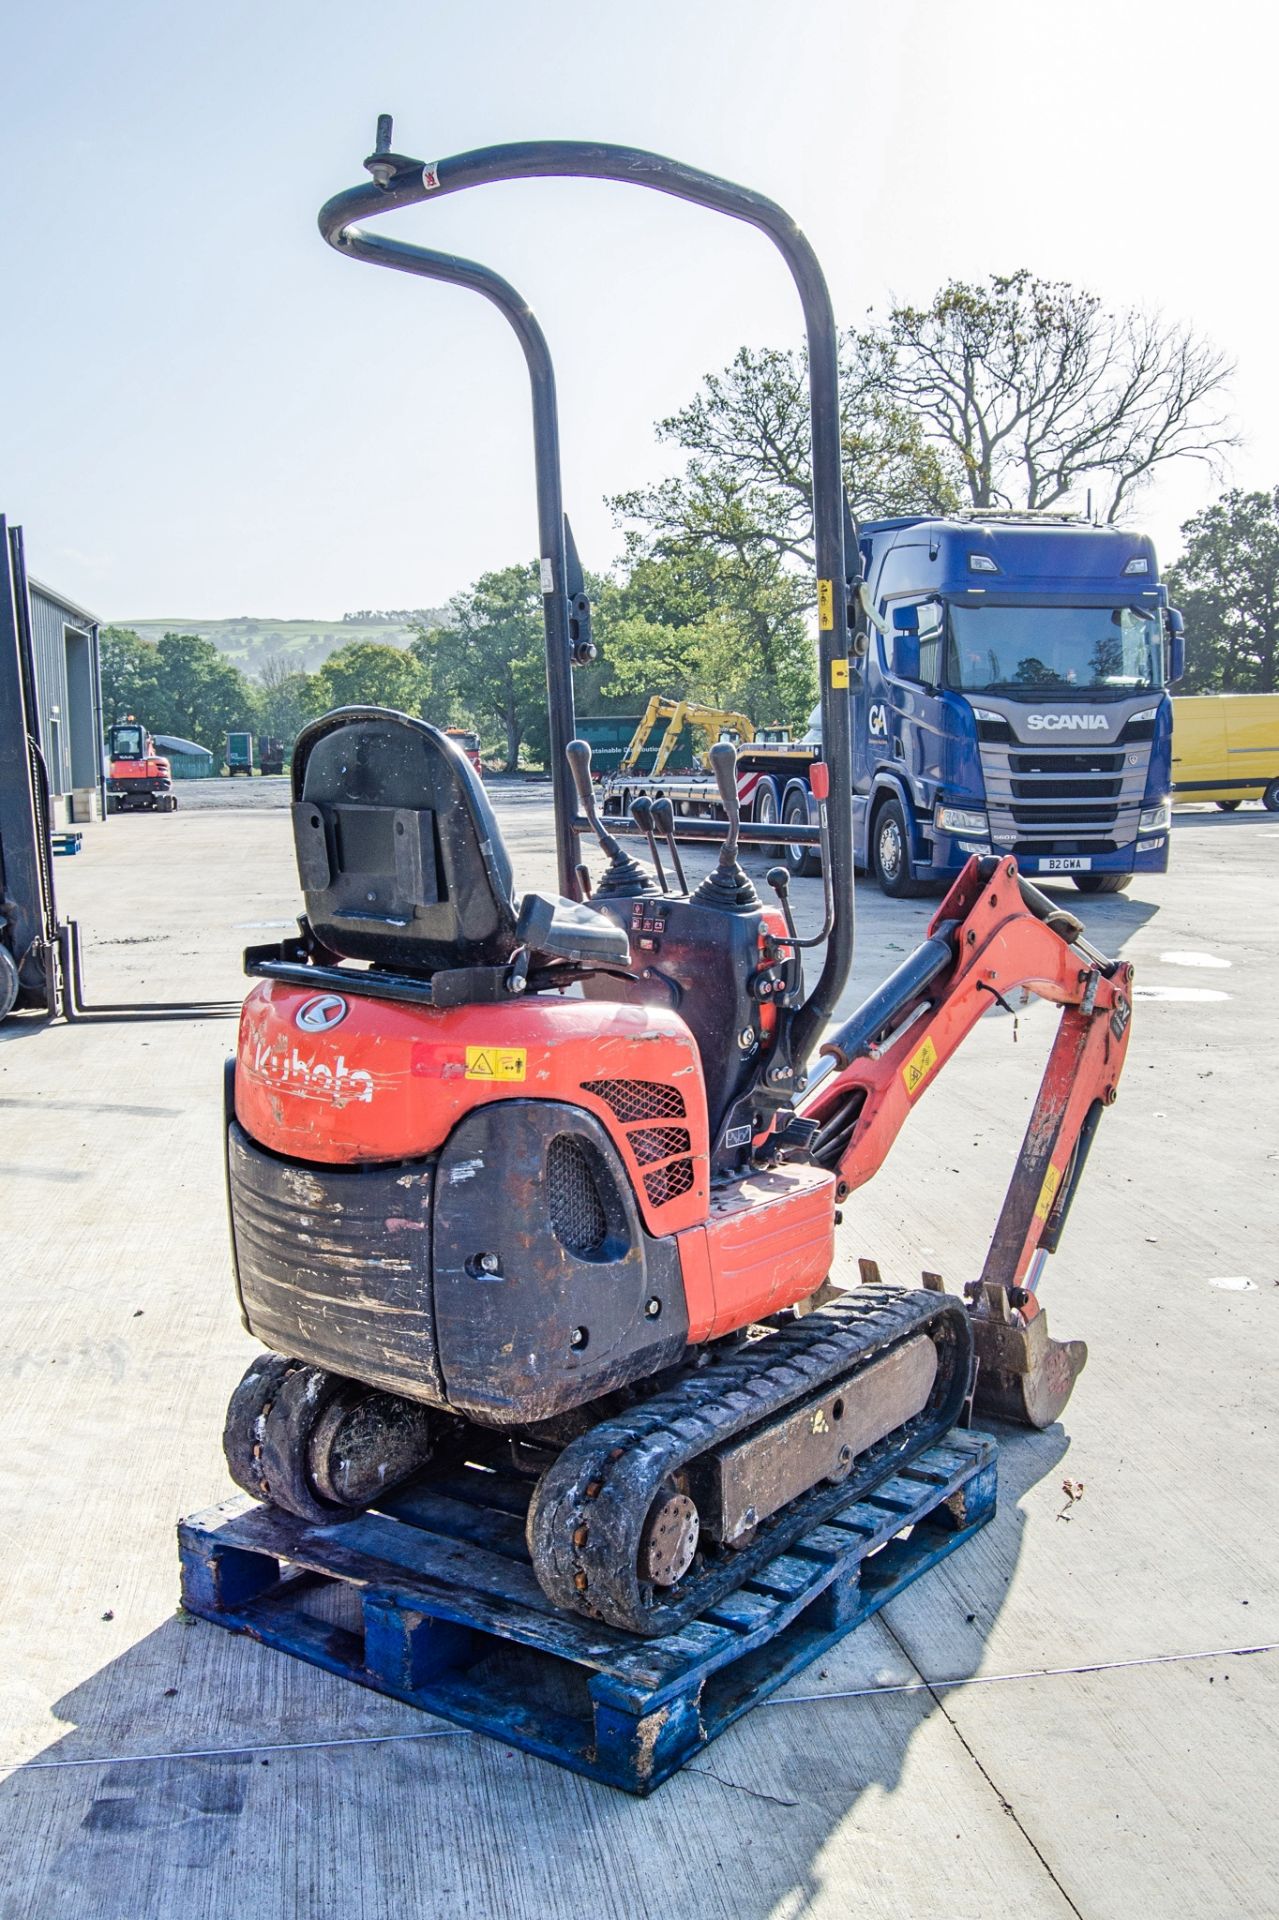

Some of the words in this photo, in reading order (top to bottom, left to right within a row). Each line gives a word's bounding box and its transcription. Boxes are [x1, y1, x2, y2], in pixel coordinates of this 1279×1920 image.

[1027, 714, 1109, 730] SCANIA
[1049, 859, 1061, 869] B2
[1064, 859, 1081, 869] GWA
